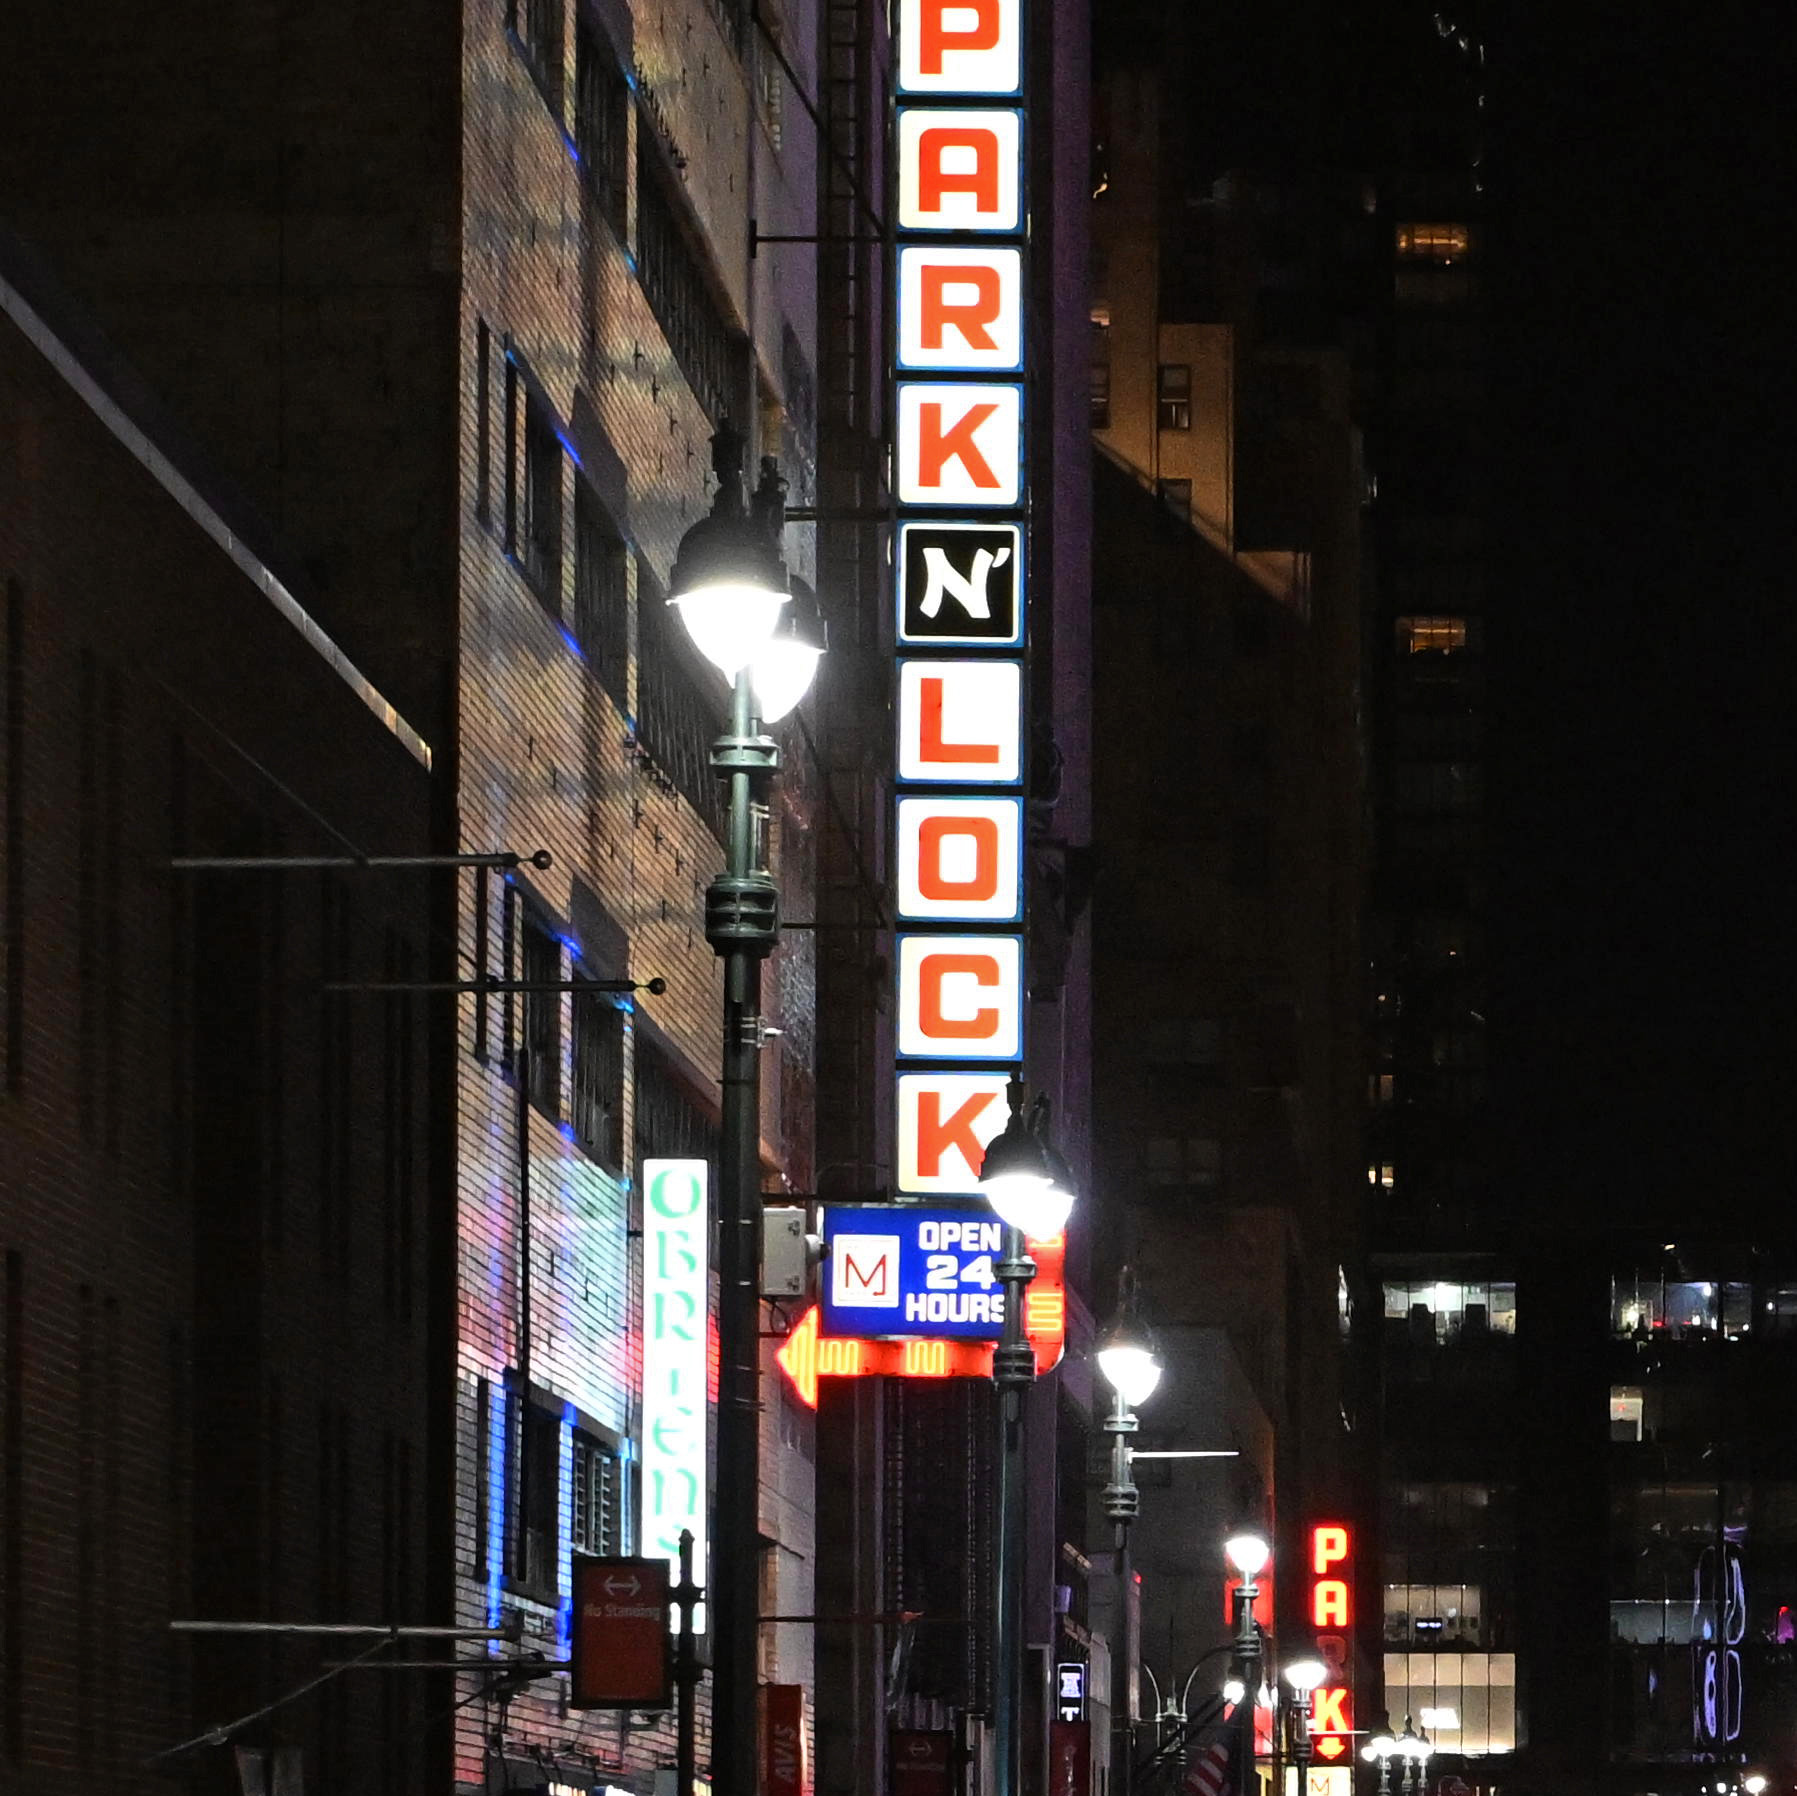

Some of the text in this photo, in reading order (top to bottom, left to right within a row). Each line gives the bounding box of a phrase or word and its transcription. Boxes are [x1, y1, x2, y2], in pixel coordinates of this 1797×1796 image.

[917, 0, 1002, 489] PARK
[917, 677, 1001, 1177] LOCK
[918, 1221, 1002, 1252] OPEN
[926, 1255, 996, 1290] 24
[905, 1293, 1006, 1323] HOURS
[1313, 1527, 1348, 1733] PARK
[774, 1724, 797, 1784] AVIS
